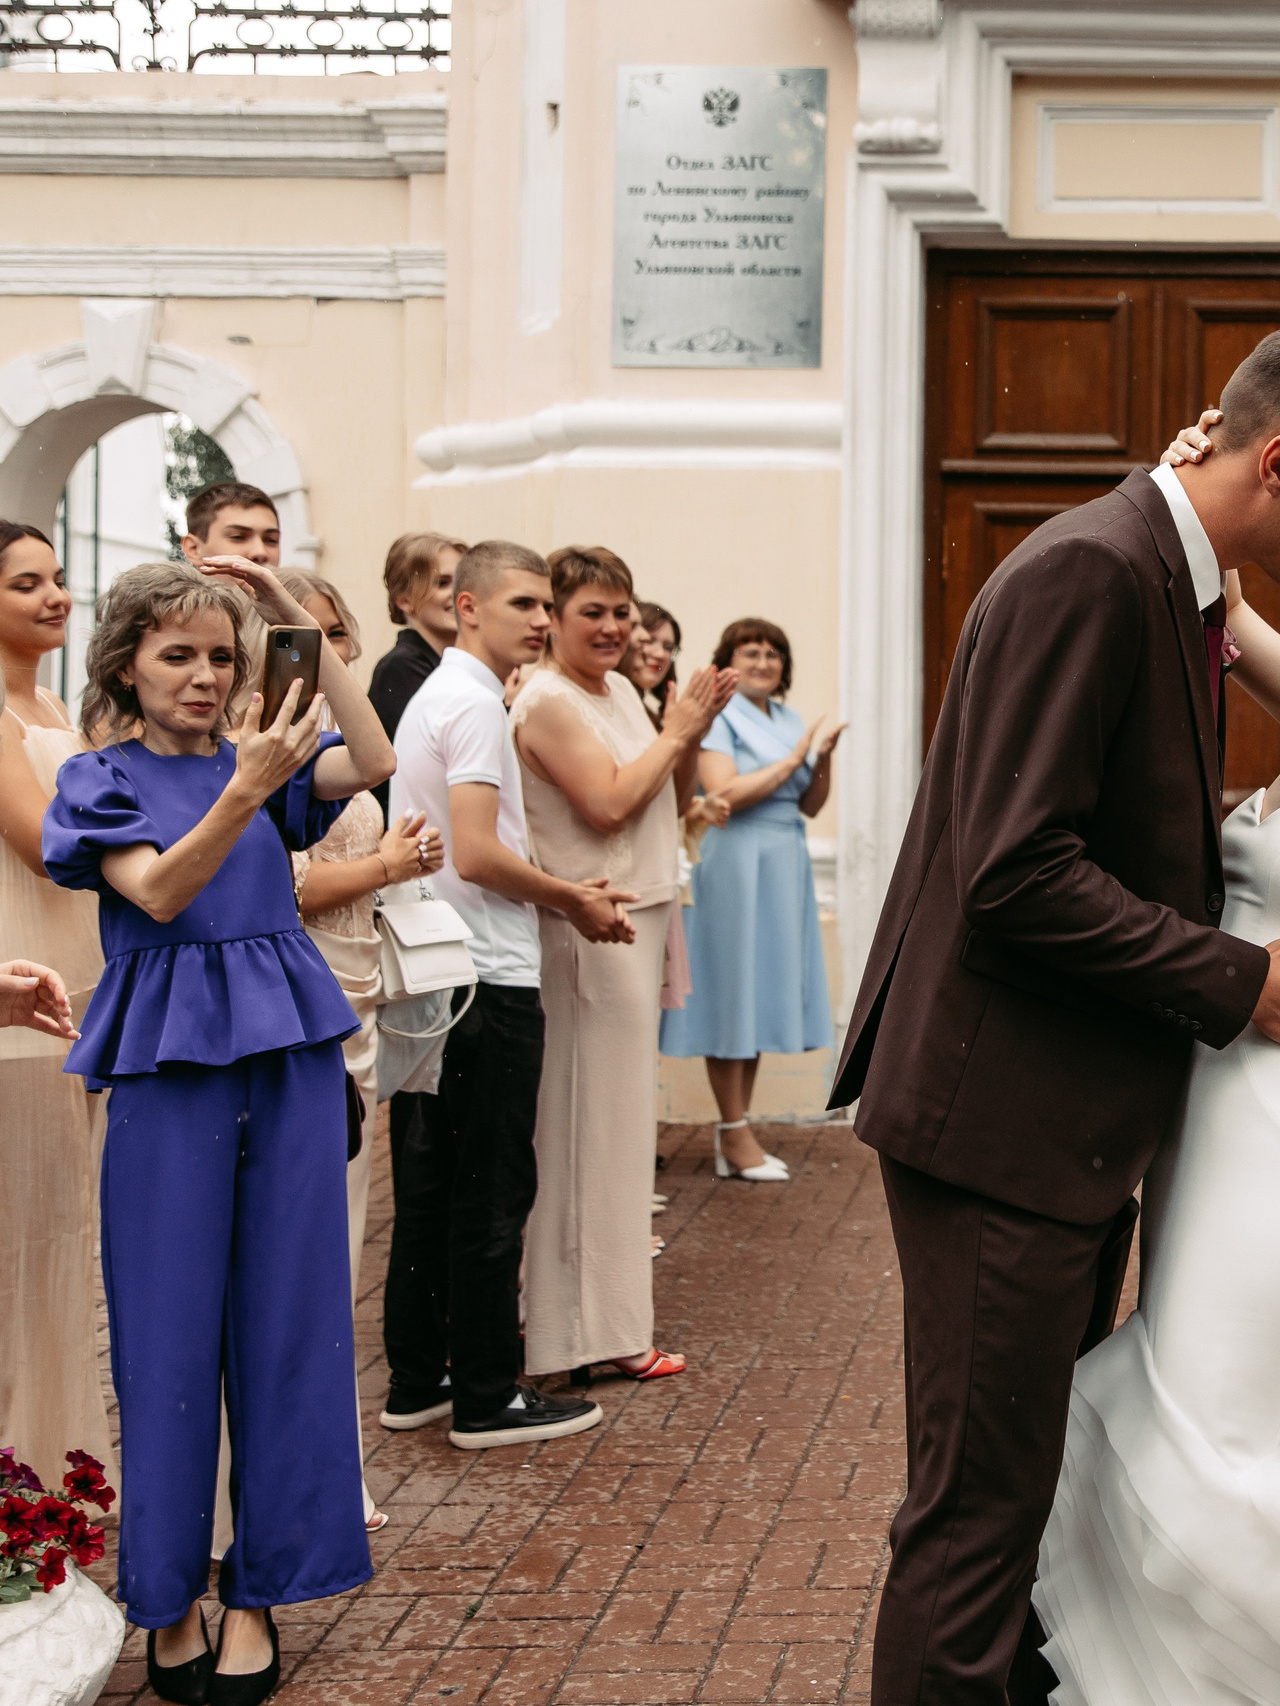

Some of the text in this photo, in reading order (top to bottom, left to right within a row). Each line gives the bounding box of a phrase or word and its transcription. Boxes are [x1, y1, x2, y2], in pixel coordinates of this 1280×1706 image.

[666, 155, 773, 171] Отдел ЗАГС
[627, 180, 810, 201] по Ленинскому району
[643, 208, 793, 225] города Ульяновска
[649, 234, 787, 250] Агентства ЗАГС
[634, 259, 801, 277] Ульяновской области
